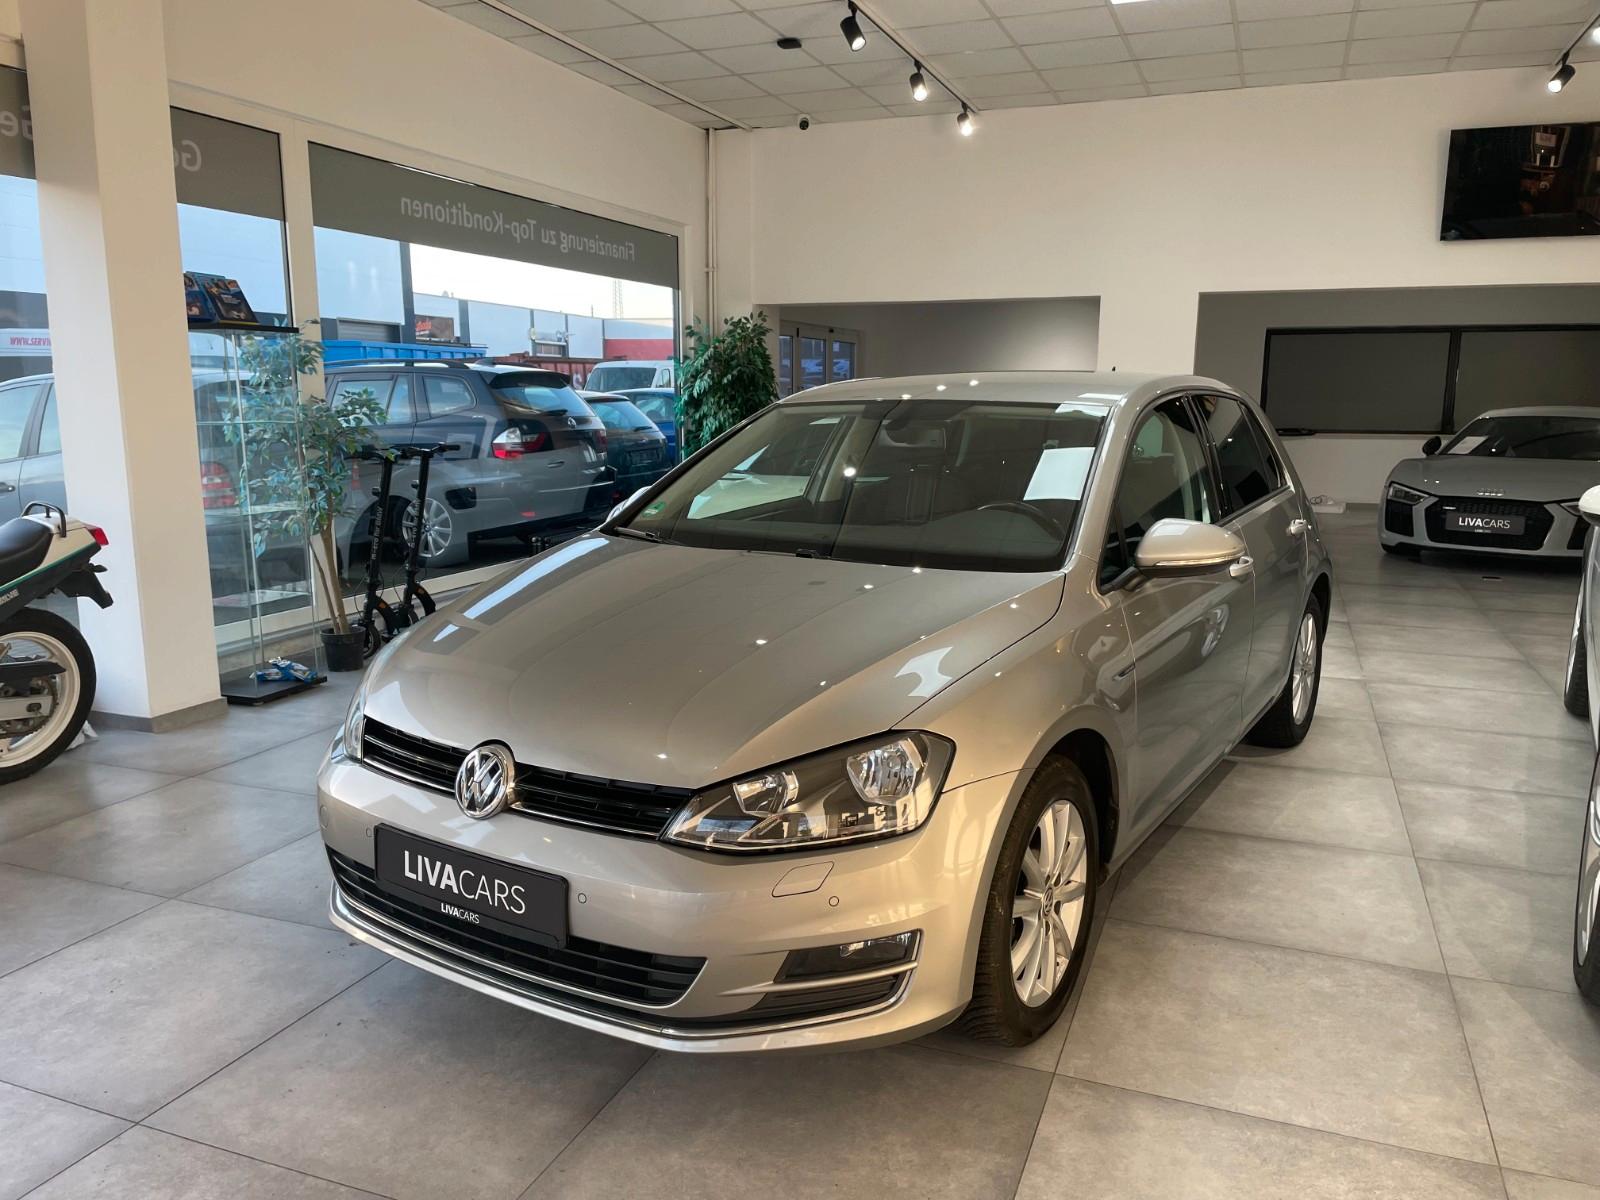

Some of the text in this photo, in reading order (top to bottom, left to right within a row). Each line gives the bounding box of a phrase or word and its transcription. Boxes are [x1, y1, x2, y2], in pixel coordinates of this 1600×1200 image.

[1458, 516, 1511, 529] LIVACARS
[404, 850, 526, 914] LIVACARS
[441, 902, 480, 924] LIVACARS
